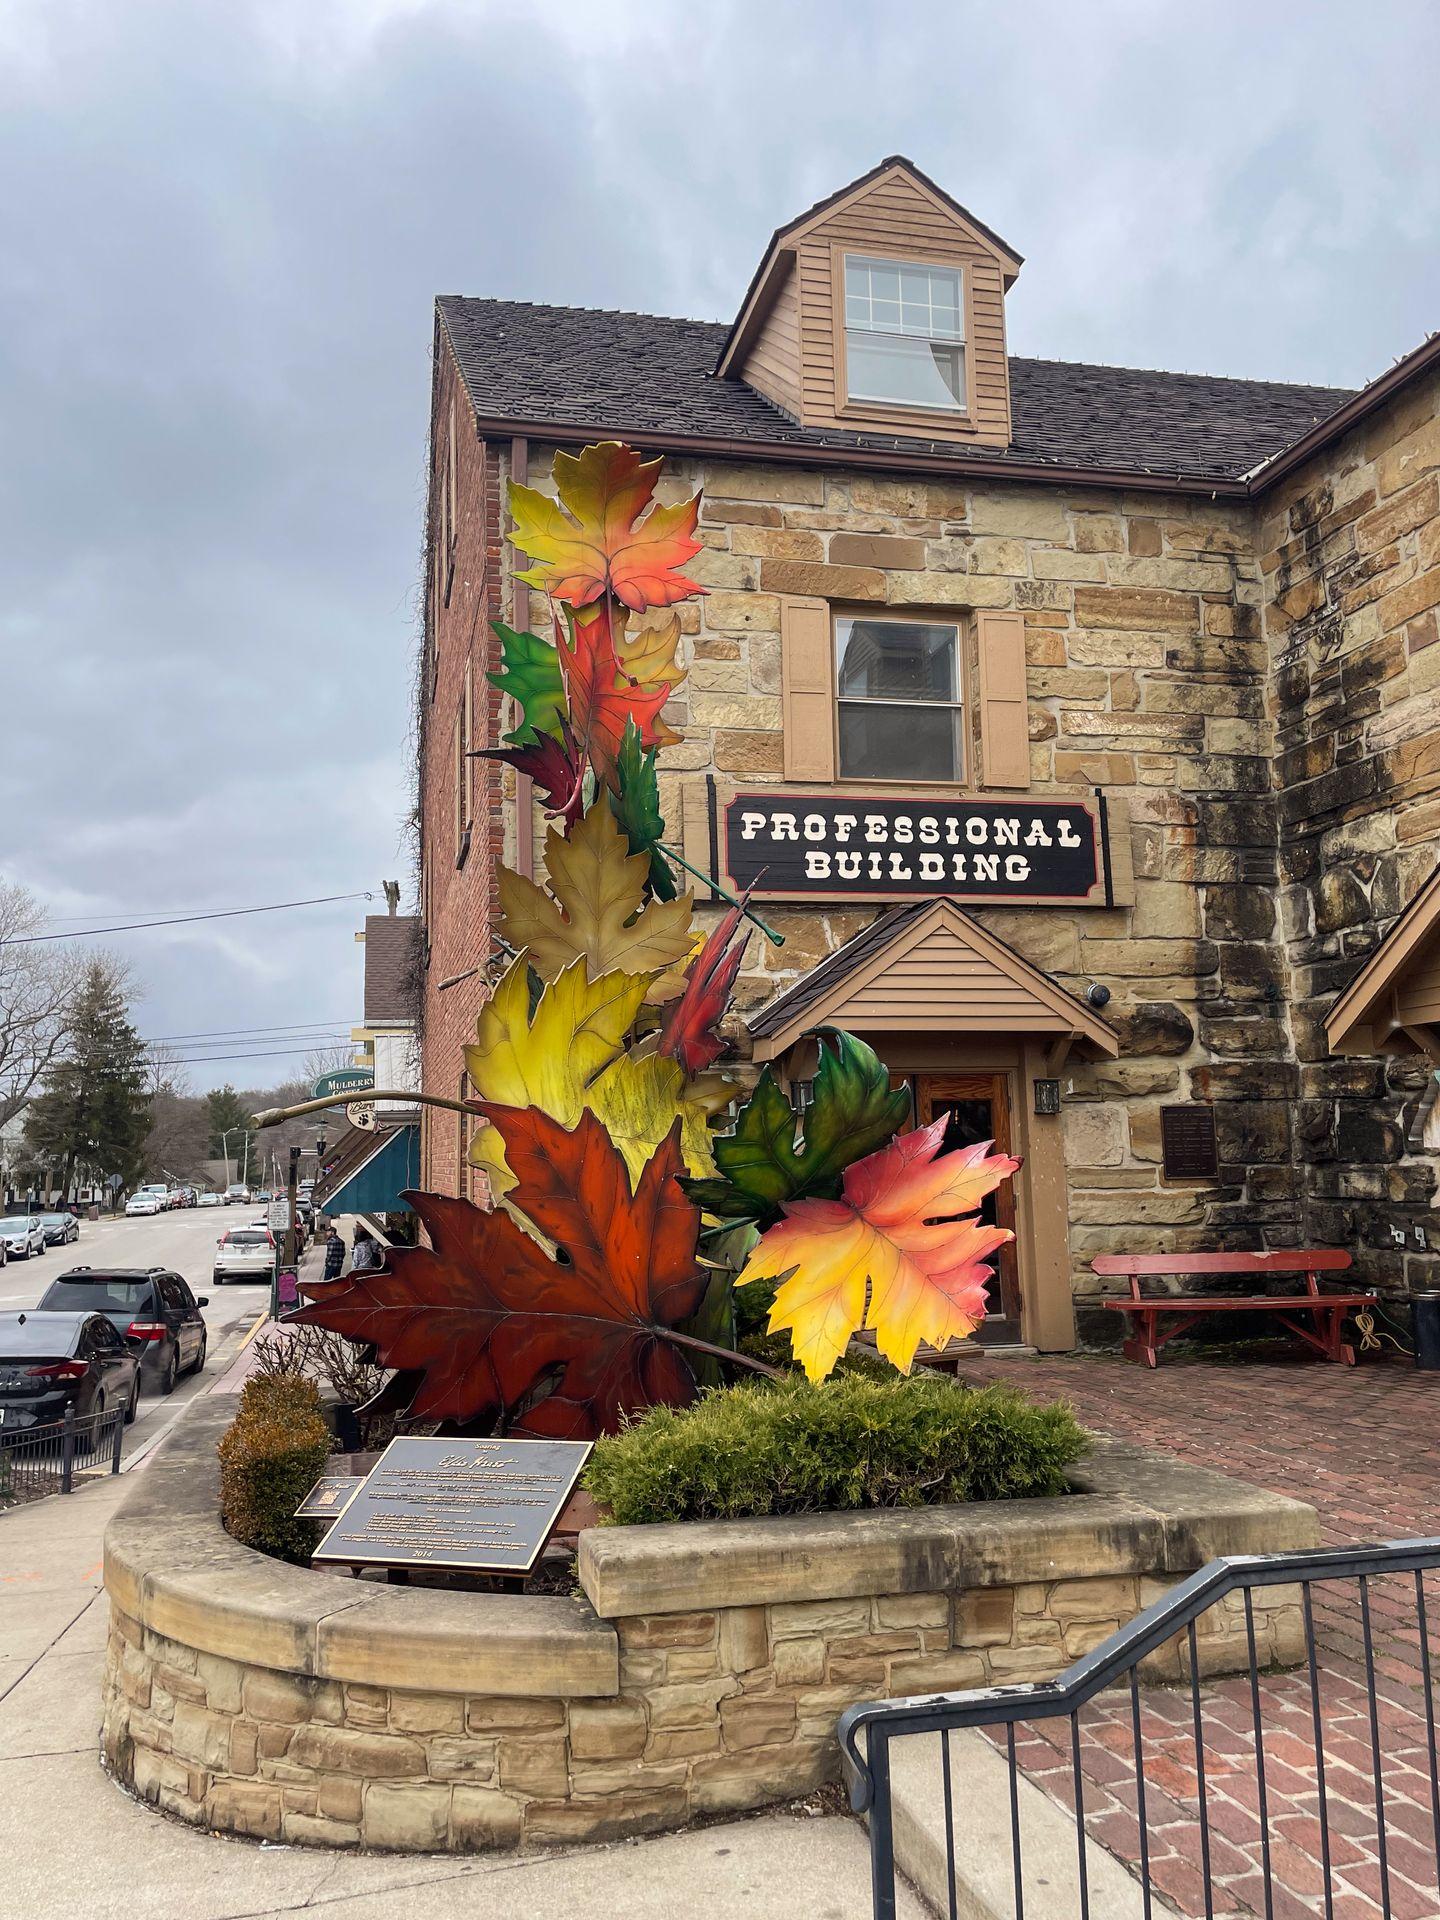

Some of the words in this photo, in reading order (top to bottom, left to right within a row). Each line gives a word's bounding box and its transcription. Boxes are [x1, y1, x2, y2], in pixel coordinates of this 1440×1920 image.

[740, 812, 1082, 848] PROFESSIONAL
[804, 851, 1032, 882] BUILDING
[328, 1078, 374, 1090] MULBERRY
[411, 1550, 433, 1558] 2014
